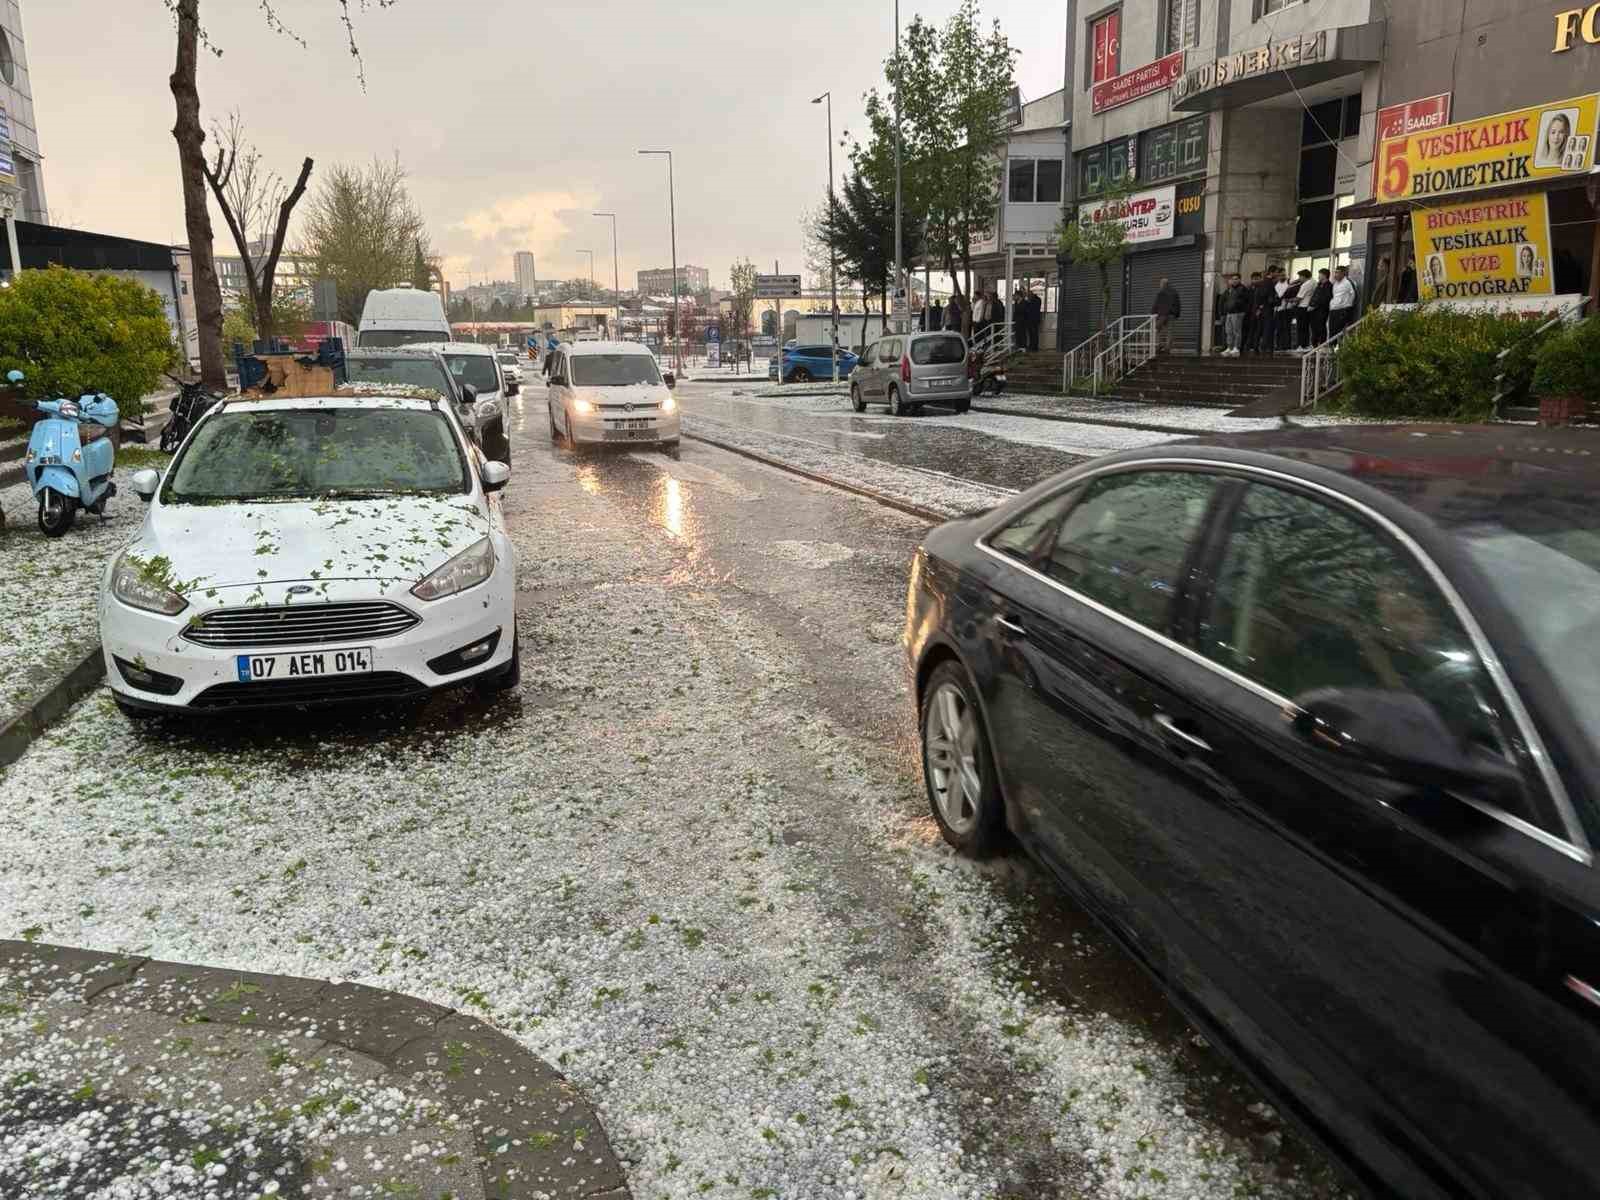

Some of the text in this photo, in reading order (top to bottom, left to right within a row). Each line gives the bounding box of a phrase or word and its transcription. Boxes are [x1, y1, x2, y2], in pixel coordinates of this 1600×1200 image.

[1232, 30, 1327, 78] MERKEZİ
[1112, 75, 1135, 90] SAADET
[1407, 112, 1444, 130] SAADET
[1418, 118, 1530, 161] VESİKALIK
[1383, 138, 1409, 198] 5
[1412, 152, 1531, 195] BİOMETRİK
[1427, 200, 1529, 229] BİOMETRİK
[1432, 226, 1528, 252] VESİKALIK
[1459, 253, 1500, 273] VİZE
[1435, 275, 1532, 298] FOTOĞRAF
[252, 657, 275, 678] 07
[289, 653, 325, 676] AEM
[335, 651, 367, 672] 014
